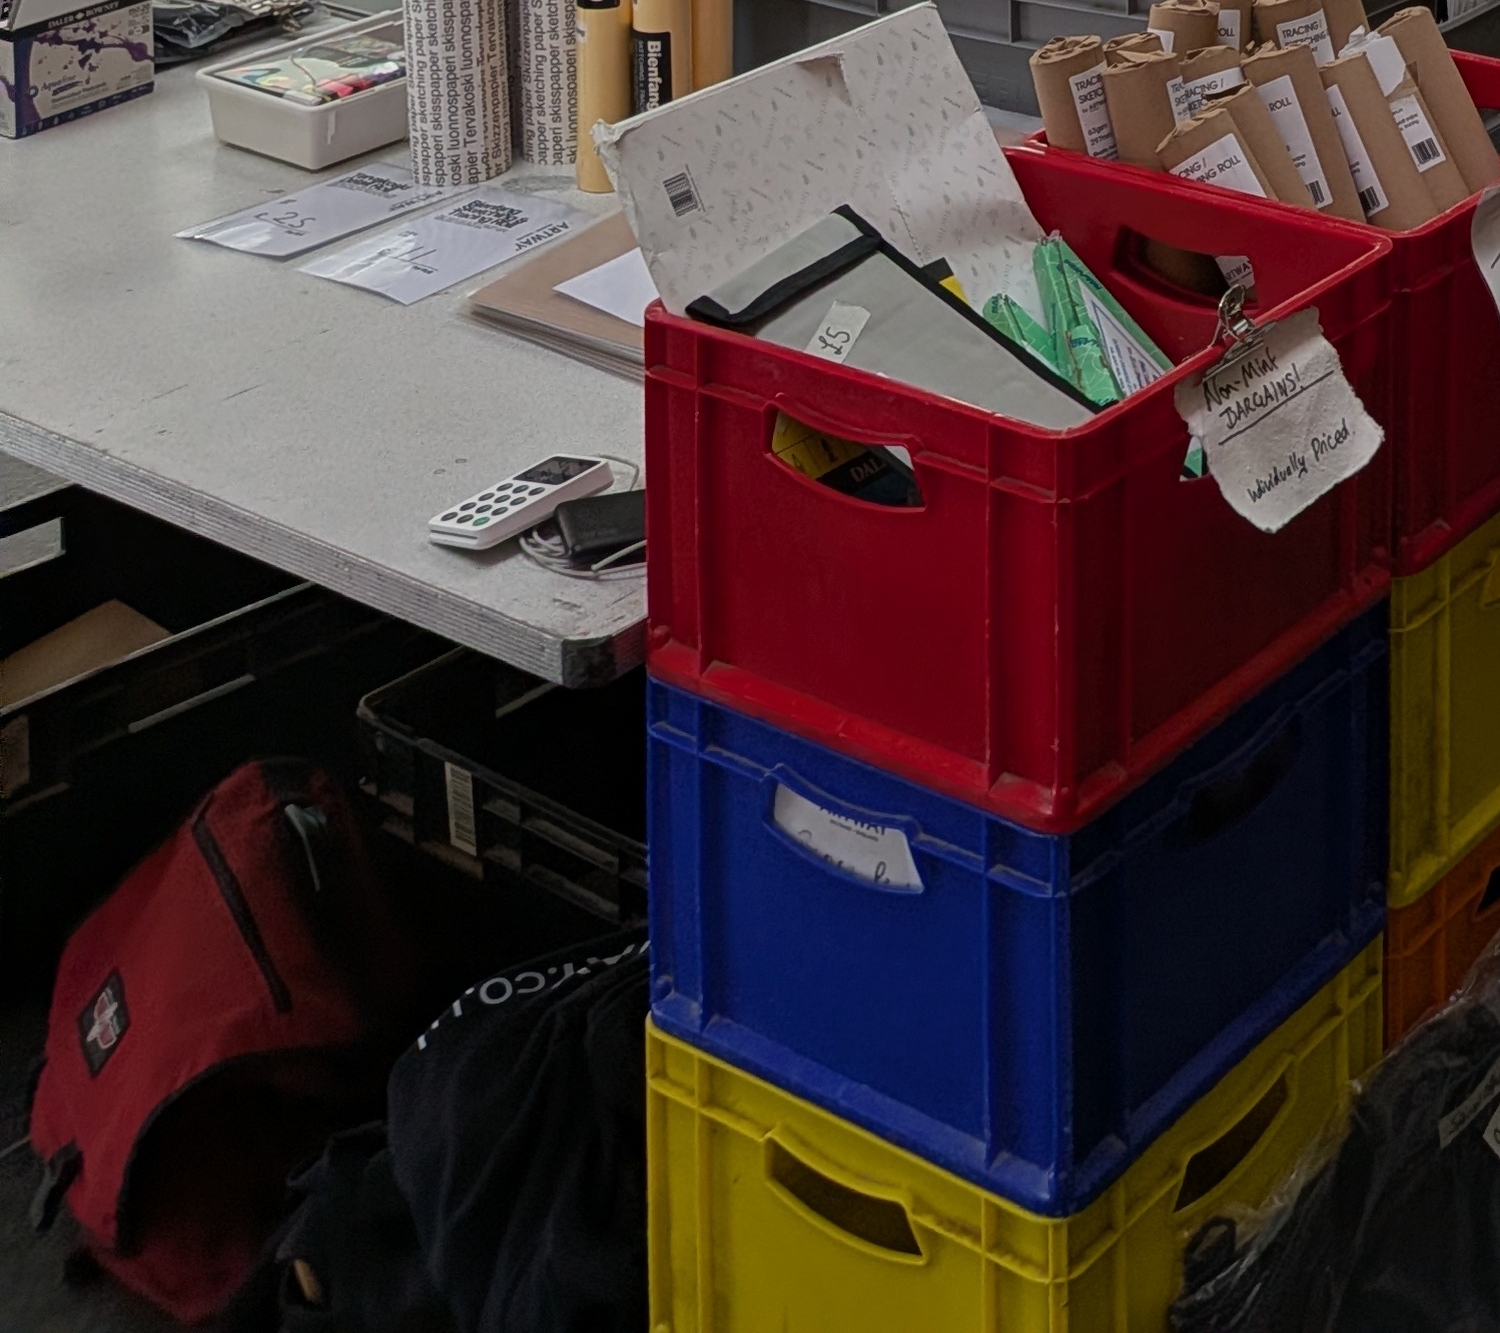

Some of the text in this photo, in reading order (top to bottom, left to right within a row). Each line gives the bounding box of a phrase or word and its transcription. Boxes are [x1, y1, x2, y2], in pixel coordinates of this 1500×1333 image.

[414, 17, 426, 56] paper
[532, 12, 546, 51] paper
[1282, 22, 1319, 39] TRACING
[416, 61, 428, 123] sketching
[428, 51, 443, 130] skisspapper
[443, 56, 460, 150] luonnospaperi
[461, 74, 478, 147] Tervakoski
[534, 55, 546, 117] sketching
[548, 44, 563, 123] skisspapper
[1269, 97, 1292, 112] ROLL
[1217, 155, 1241, 174] ROLL
[818, 325, 851, 355] £5
[1203, 346, 1280, 412] Non-Mint
[1219, 363, 1305, 430] BARGAINS!
